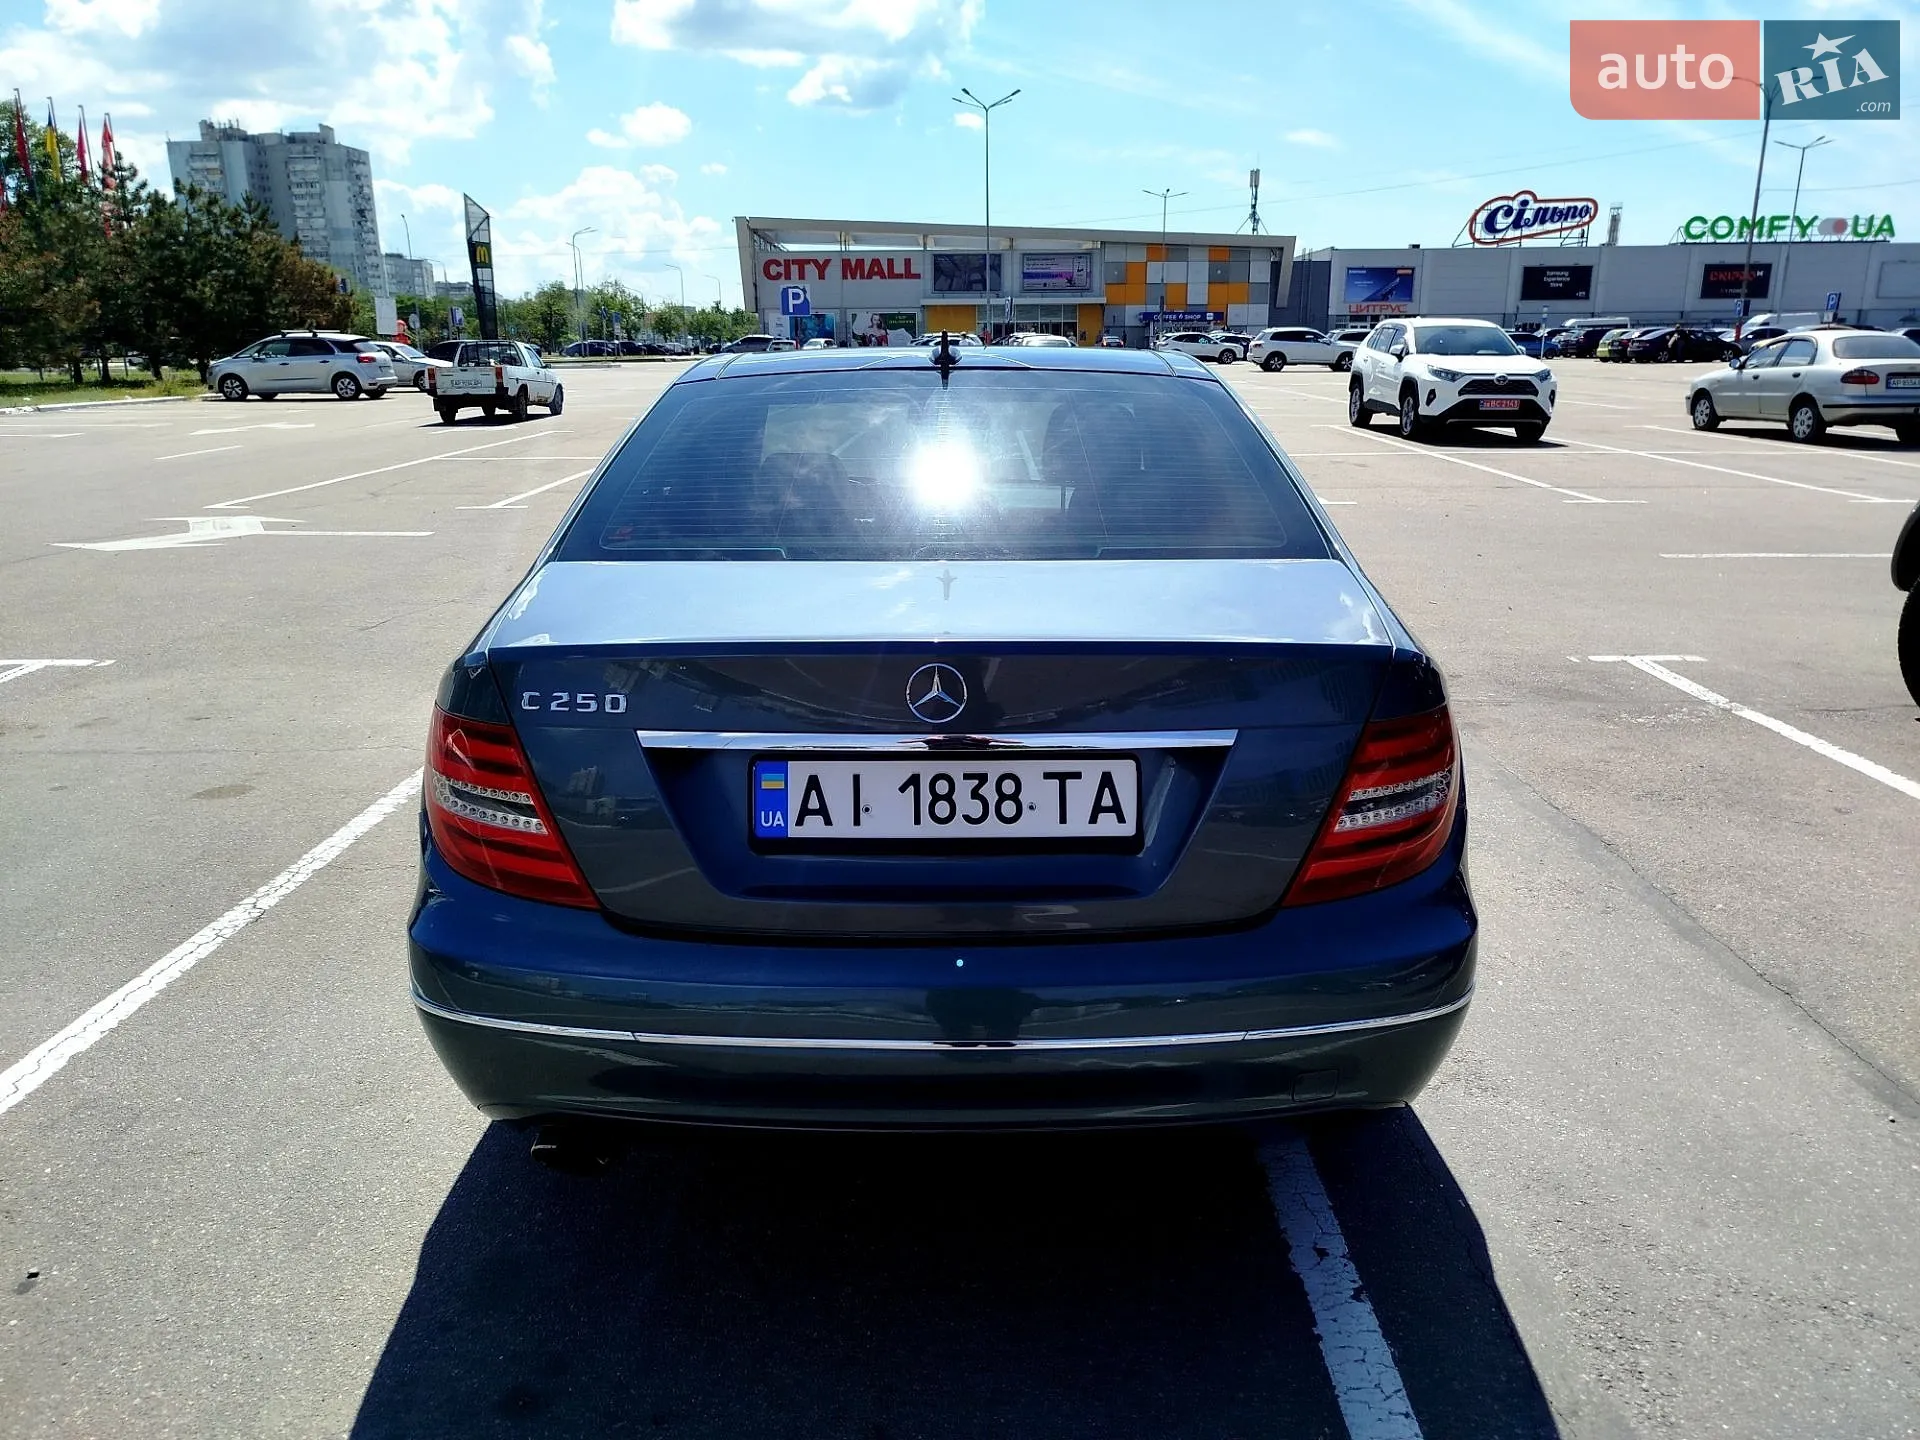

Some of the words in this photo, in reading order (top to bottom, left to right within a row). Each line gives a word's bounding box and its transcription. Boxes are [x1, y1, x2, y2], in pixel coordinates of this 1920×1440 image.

[1484, 199, 1593, 235] Сільпо
[1684, 215, 1818, 240] COMFY
[1851, 213, 1896, 239] UA
[762, 258, 832, 282] CITY
[841, 257, 922, 281] MALL
[787, 288, 805, 312] P
[521, 692, 539, 711] C
[549, 692, 629, 713] 250
[794, 773, 861, 828] AI
[897, 772, 1023, 826] 1838
[1042, 770, 1128, 826] TA
[759, 811, 785, 829] UA
